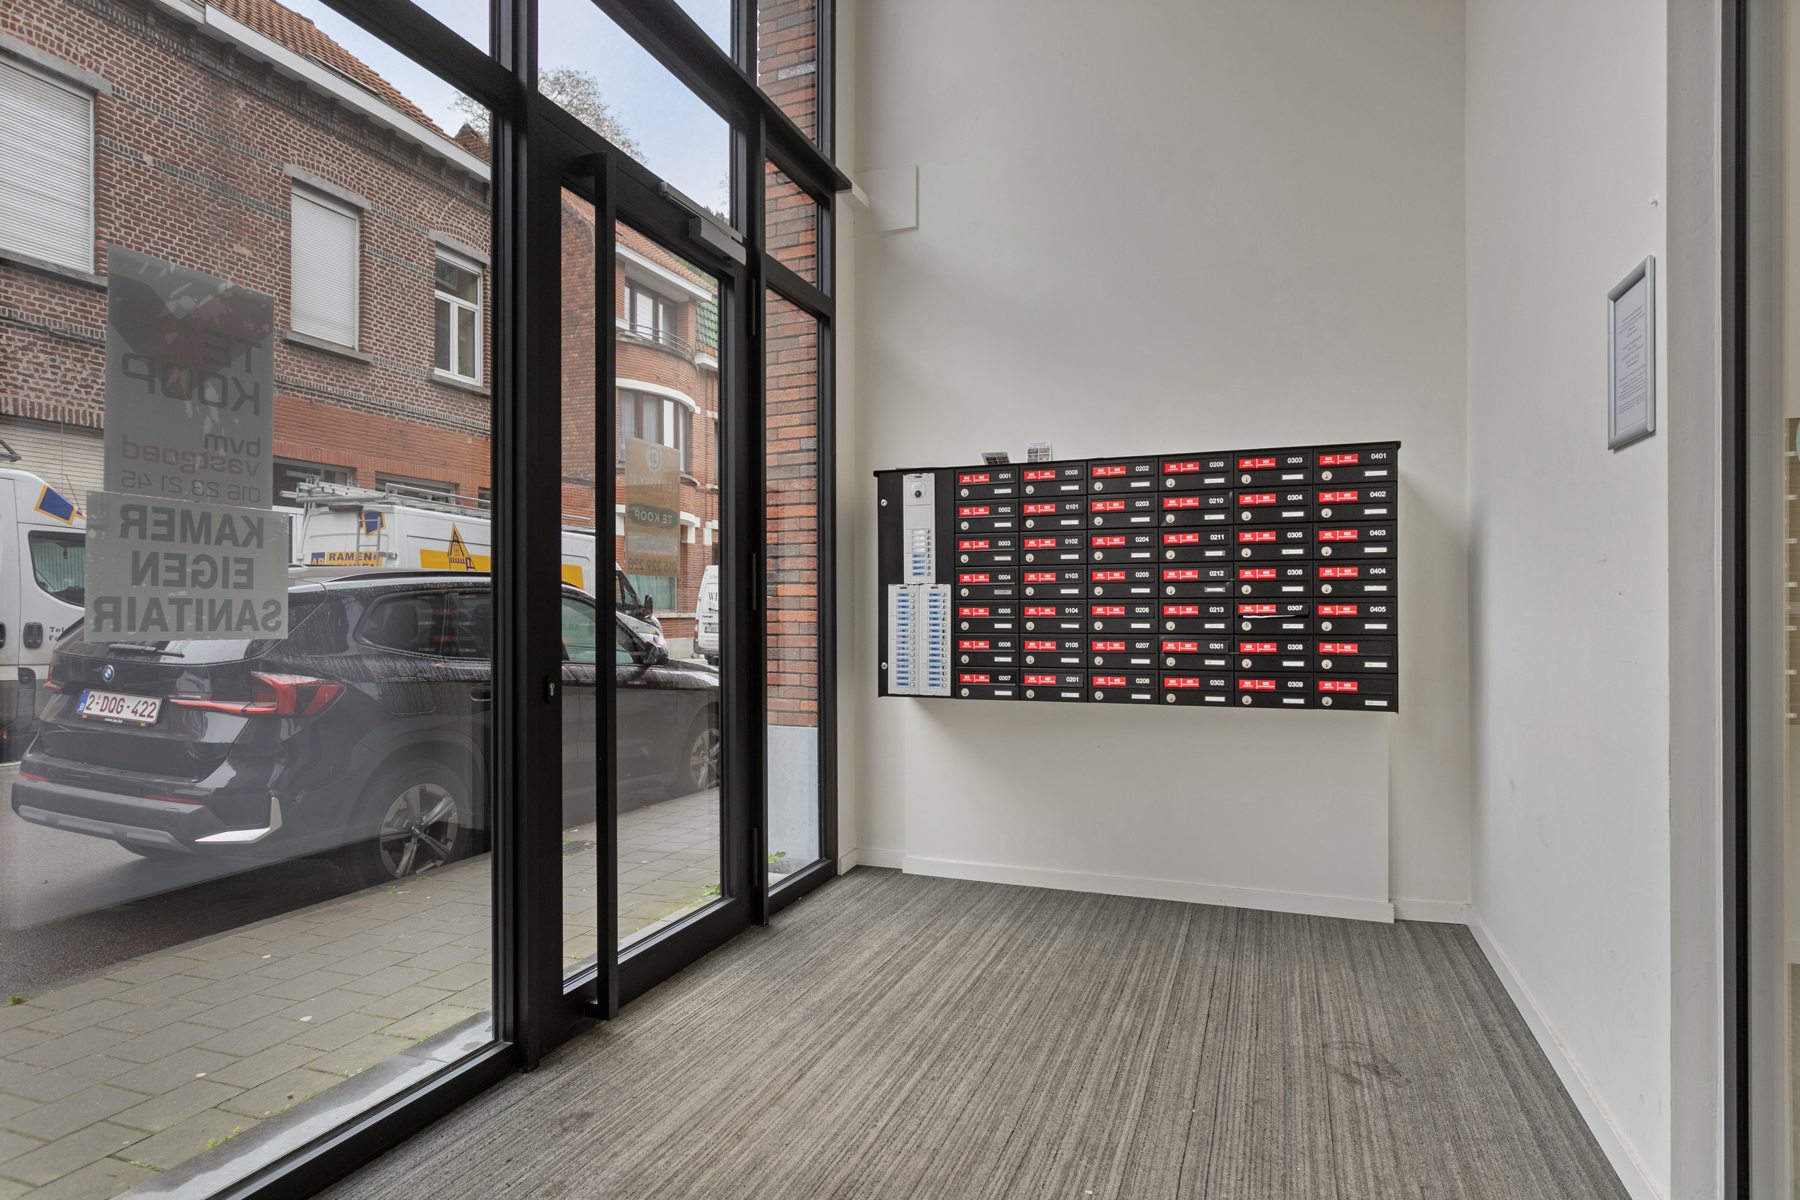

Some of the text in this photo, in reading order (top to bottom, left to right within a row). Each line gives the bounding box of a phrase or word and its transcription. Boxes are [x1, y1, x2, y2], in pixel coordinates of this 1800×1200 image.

[1286, 456, 1304, 464] 0303
[1370, 452, 1387, 460] 0401
[1208, 460, 1225, 468] 0209
[1286, 493, 1303, 502] 0304
[1369, 490, 1387, 498] 0402
[1208, 497, 1225, 505] 0210
[1209, 533, 1225, 541] 0211
[1286, 531, 1304, 539] 0305
[1369, 529, 1387, 537] 0403
[1208, 569, 1225, 577] 0212
[1286, 568, 1304, 576] 0306
[1369, 567, 1387, 575] 0404
[1286, 604, 1304, 612] 0307
[1369, 605, 1387, 613] 0405
[1208, 642, 1224, 650] 0301
[1287, 643, 1304, 651] 0308
[1287, 680, 1304, 688] 0309
